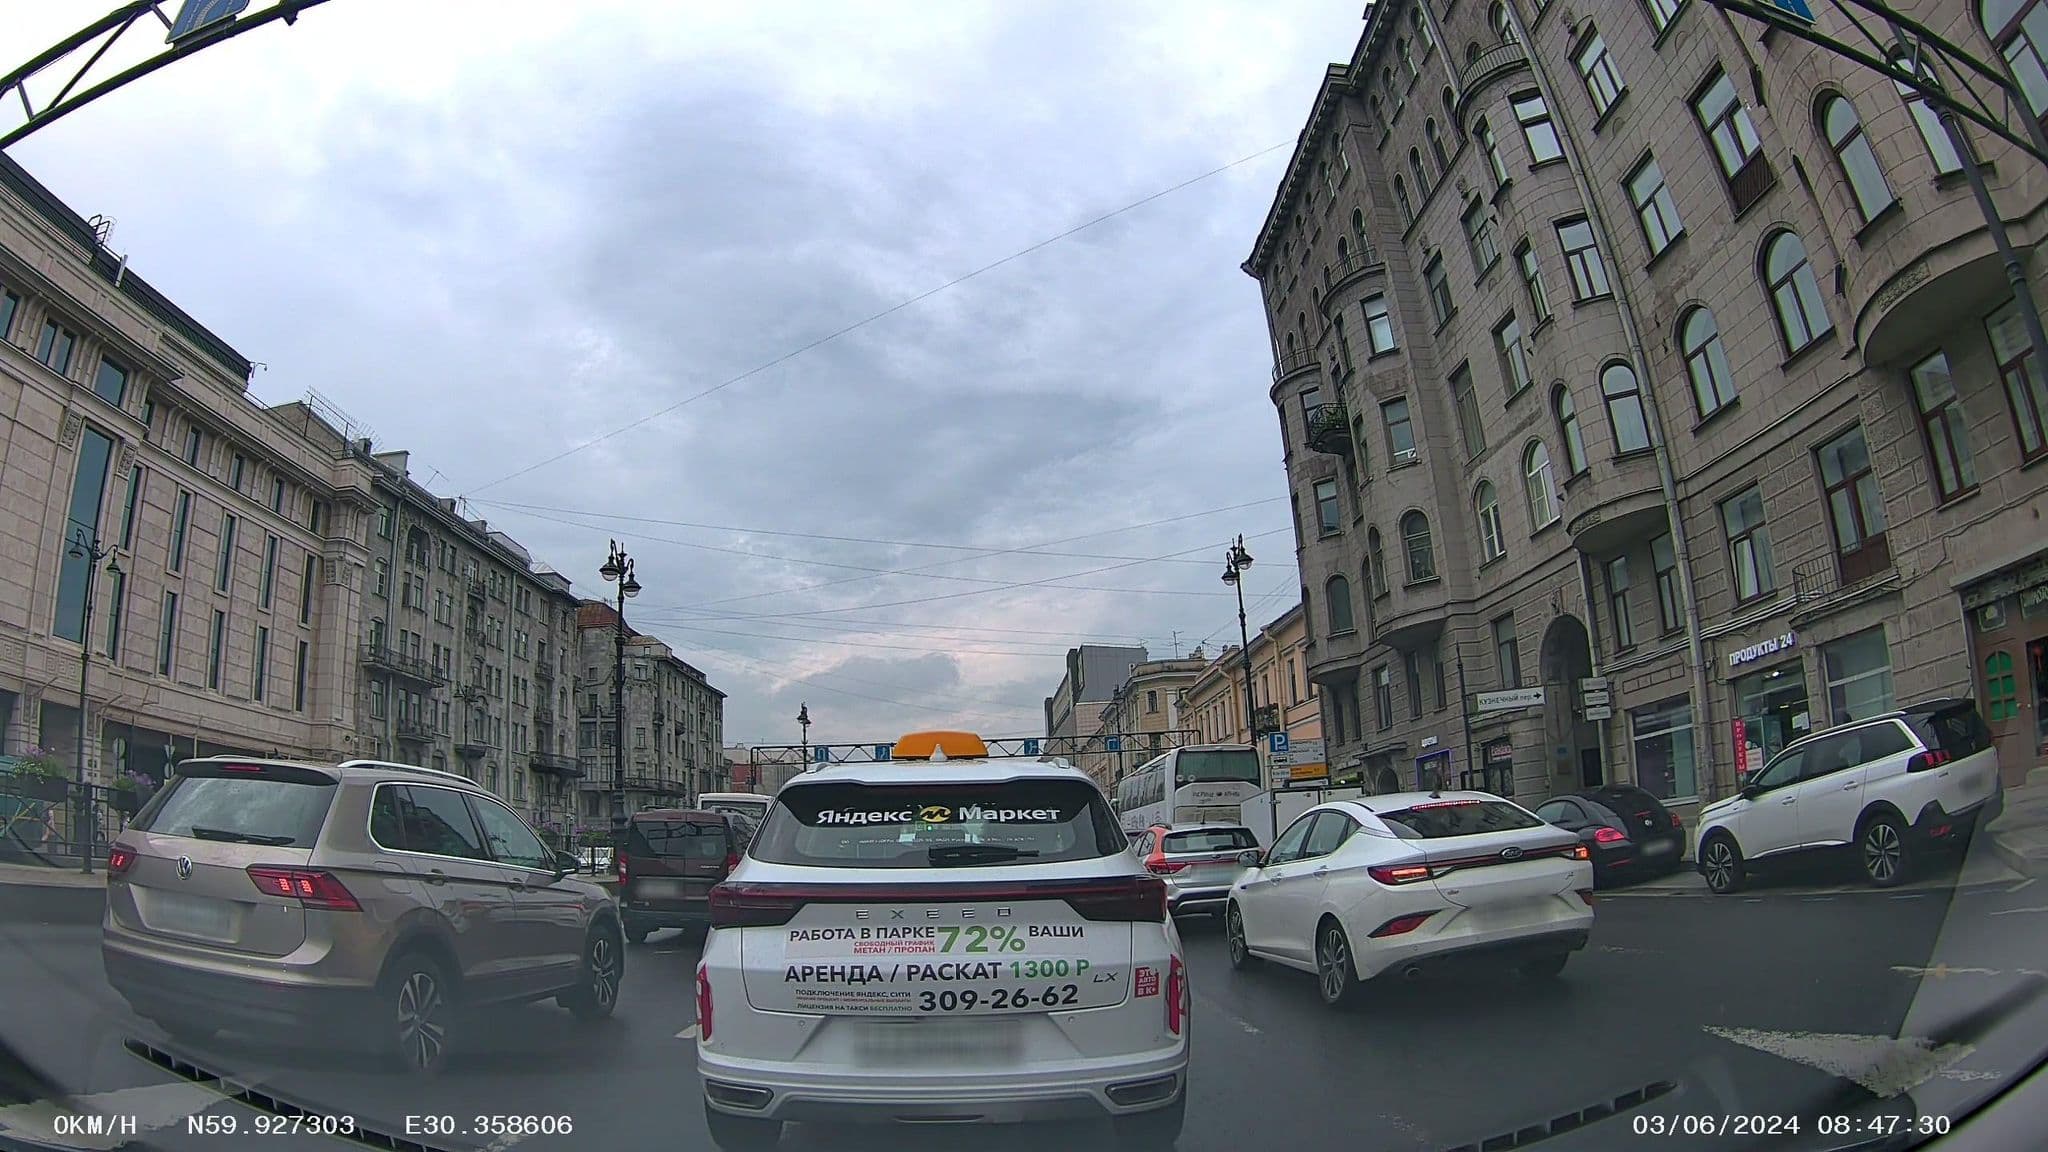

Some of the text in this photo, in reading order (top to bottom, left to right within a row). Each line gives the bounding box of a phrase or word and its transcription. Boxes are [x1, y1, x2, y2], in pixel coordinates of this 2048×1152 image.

[1729, 632, 1793, 666] ПРОДУКТЫ 24
[1274, 734, 1286, 751] P
[816, 806, 1061, 824] Яндекс Маркет
[790, 925, 1084, 953] РАБОТА В ПАРКЕ 72% ВАШИ
[785, 964, 884, 985] АРЕНДА
[890, 964, 899, 983] /
[907, 961, 1002, 982] РАСКАТ
[1010, 960, 1069, 979] 1300
[1094, 972, 1118, 983] LX
[795, 989, 855, 997] ПОДКЛЮЧЕНИЕ
[919, 984, 1078, 1012] 309-26-62
[870, 1004, 912, 1012] БЕСПЛАТНО
